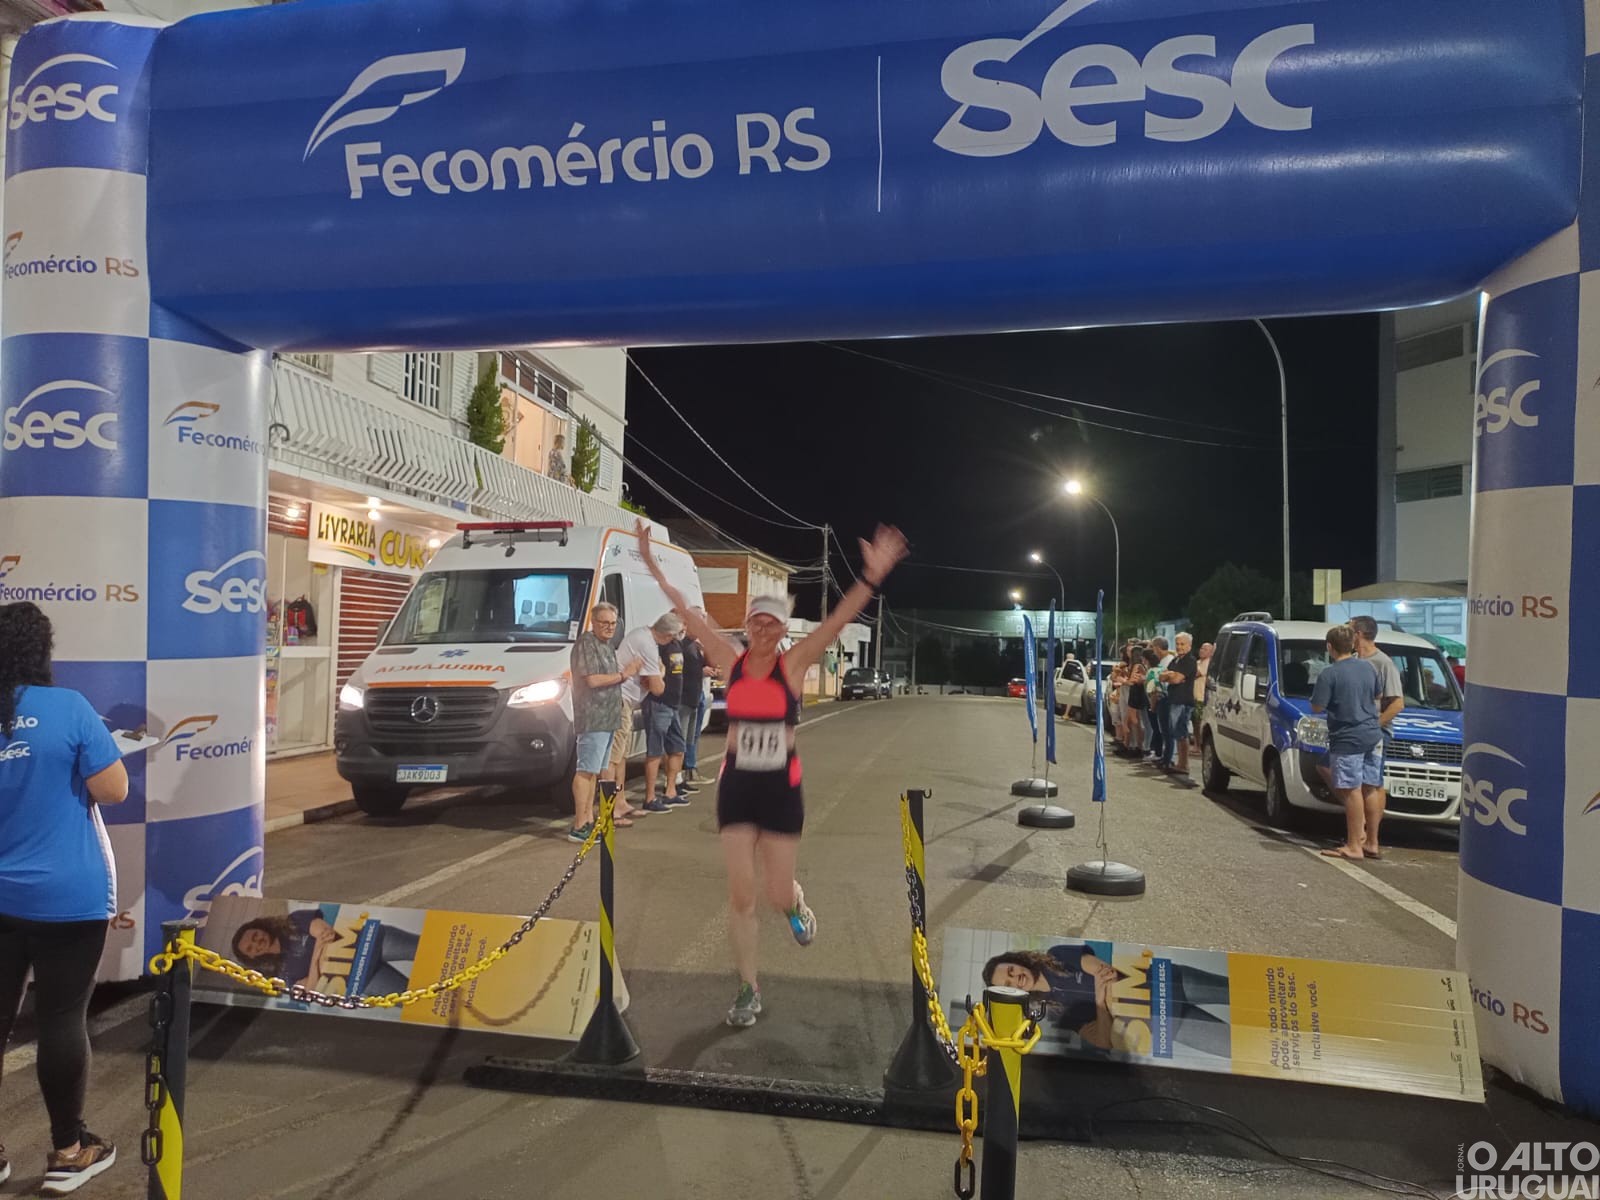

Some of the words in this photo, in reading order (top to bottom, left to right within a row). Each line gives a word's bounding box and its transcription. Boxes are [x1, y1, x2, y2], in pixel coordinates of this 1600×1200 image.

[344, 122, 714, 200] Fecomércio
[736, 107, 831, 175] RS
[105, 256, 140, 278] RS
[105, 584, 140, 602] RS
[1522, 595, 1559, 618] RS
[445, 925, 458, 959] mundo
[1266, 967, 1277, 1003] mundo
[1277, 966, 1285, 978] os
[1288, 972, 1297, 998] Sesc.
[1159, 982, 1167, 997] SER
[1307, 980, 1318, 1008] você.
[1159, 997, 1167, 1025] PODEM
[1268, 1007, 1278, 1033] todo
[1278, 981, 1290, 1037] aproveitar
[1289, 1001, 1298, 1016] do
[1513, 1002, 1549, 1034] RS
[1159, 1025, 1167, 1054] TODOS
[1290, 1019, 1301, 1066] serviços
[1311, 1011, 1321, 1060] Inclusive
[1280, 1039, 1291, 1071] pode
